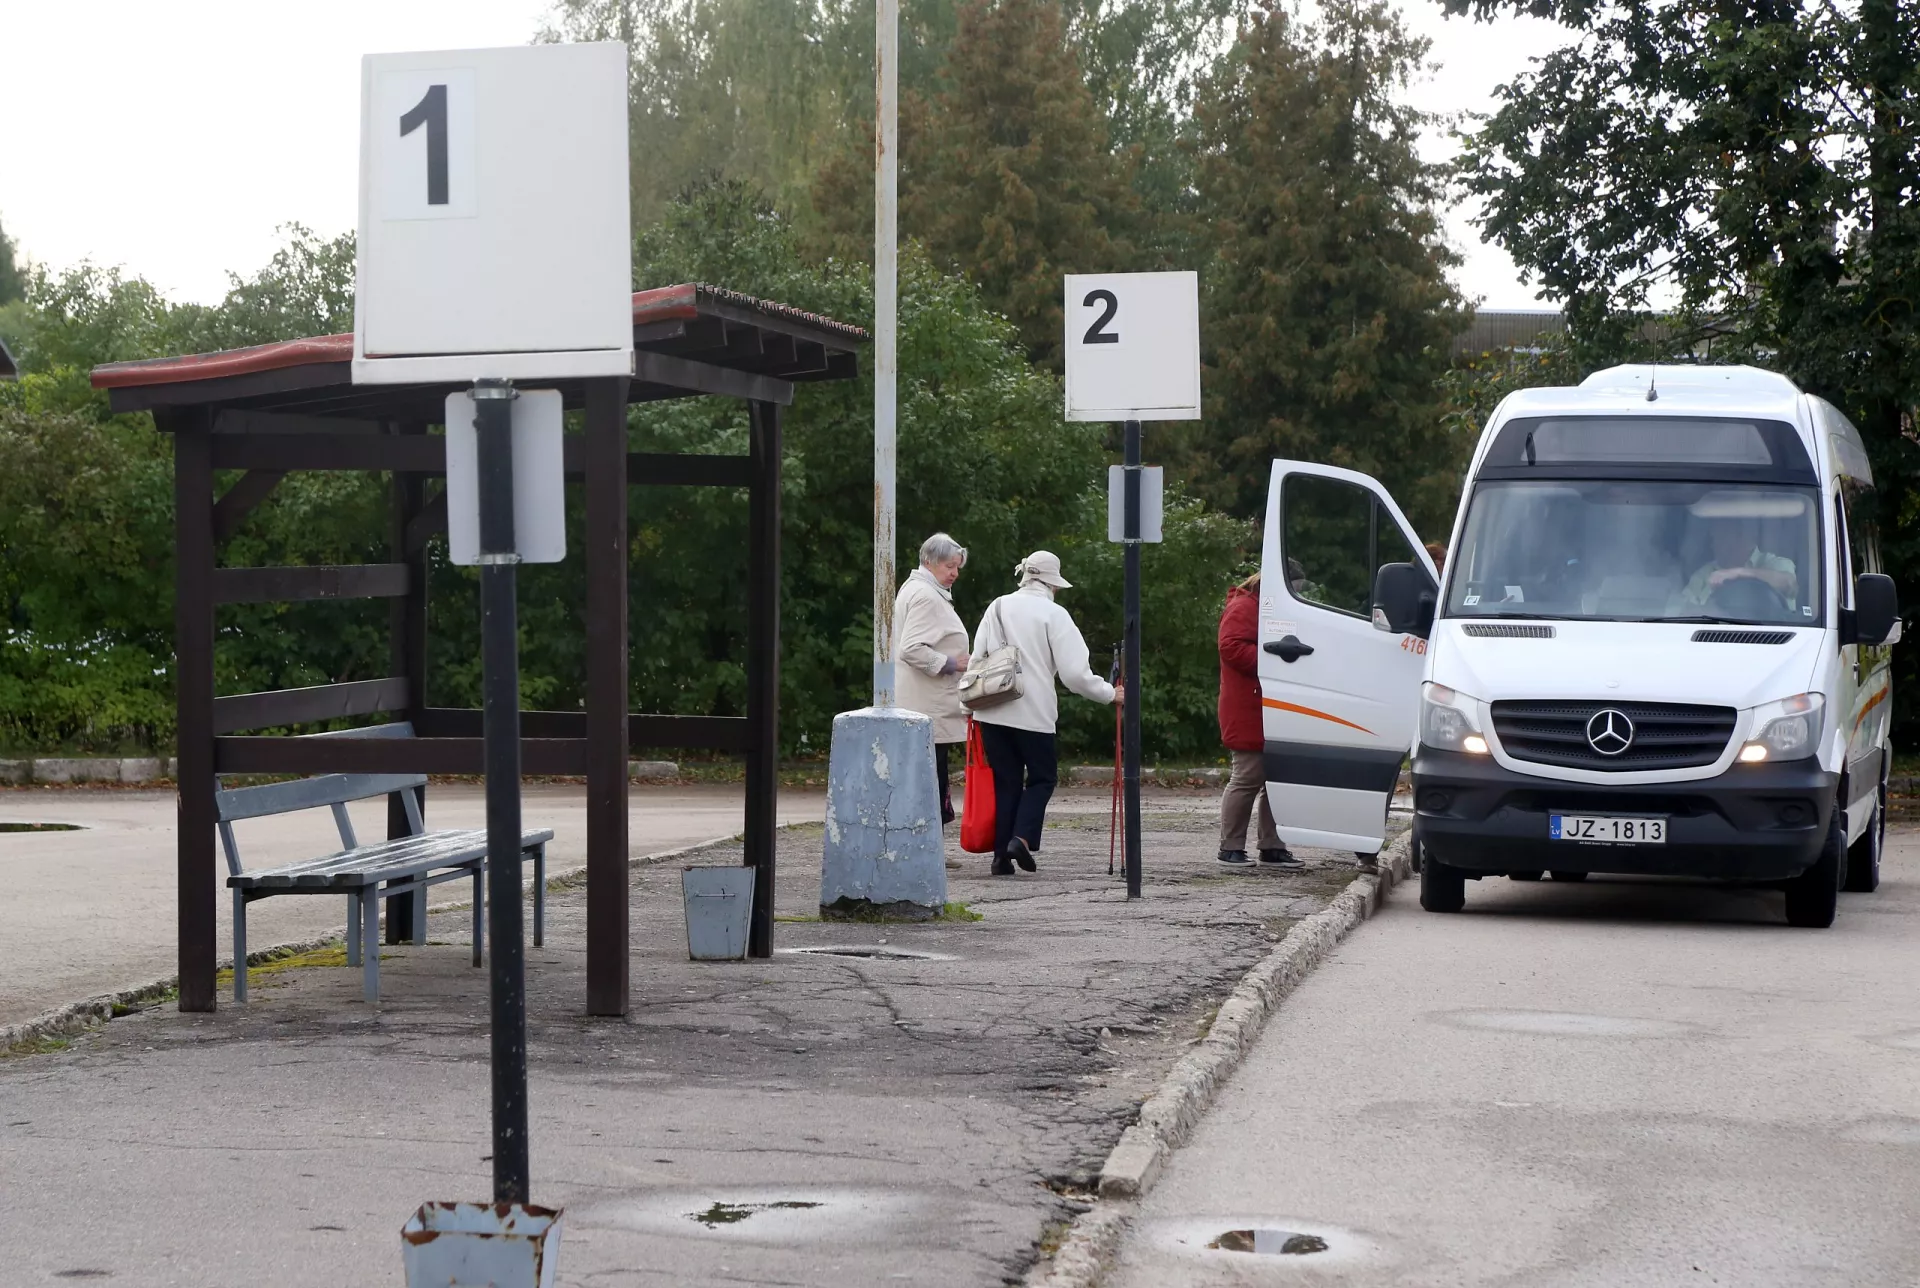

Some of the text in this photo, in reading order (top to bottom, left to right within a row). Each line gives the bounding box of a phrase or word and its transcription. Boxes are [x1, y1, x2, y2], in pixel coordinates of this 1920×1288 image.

[399, 84, 449, 205] 1
[1082, 289, 1119, 344] 2
[1400, 635, 1428, 656] 416
[1566, 819, 1662, 840] JZ-1813
